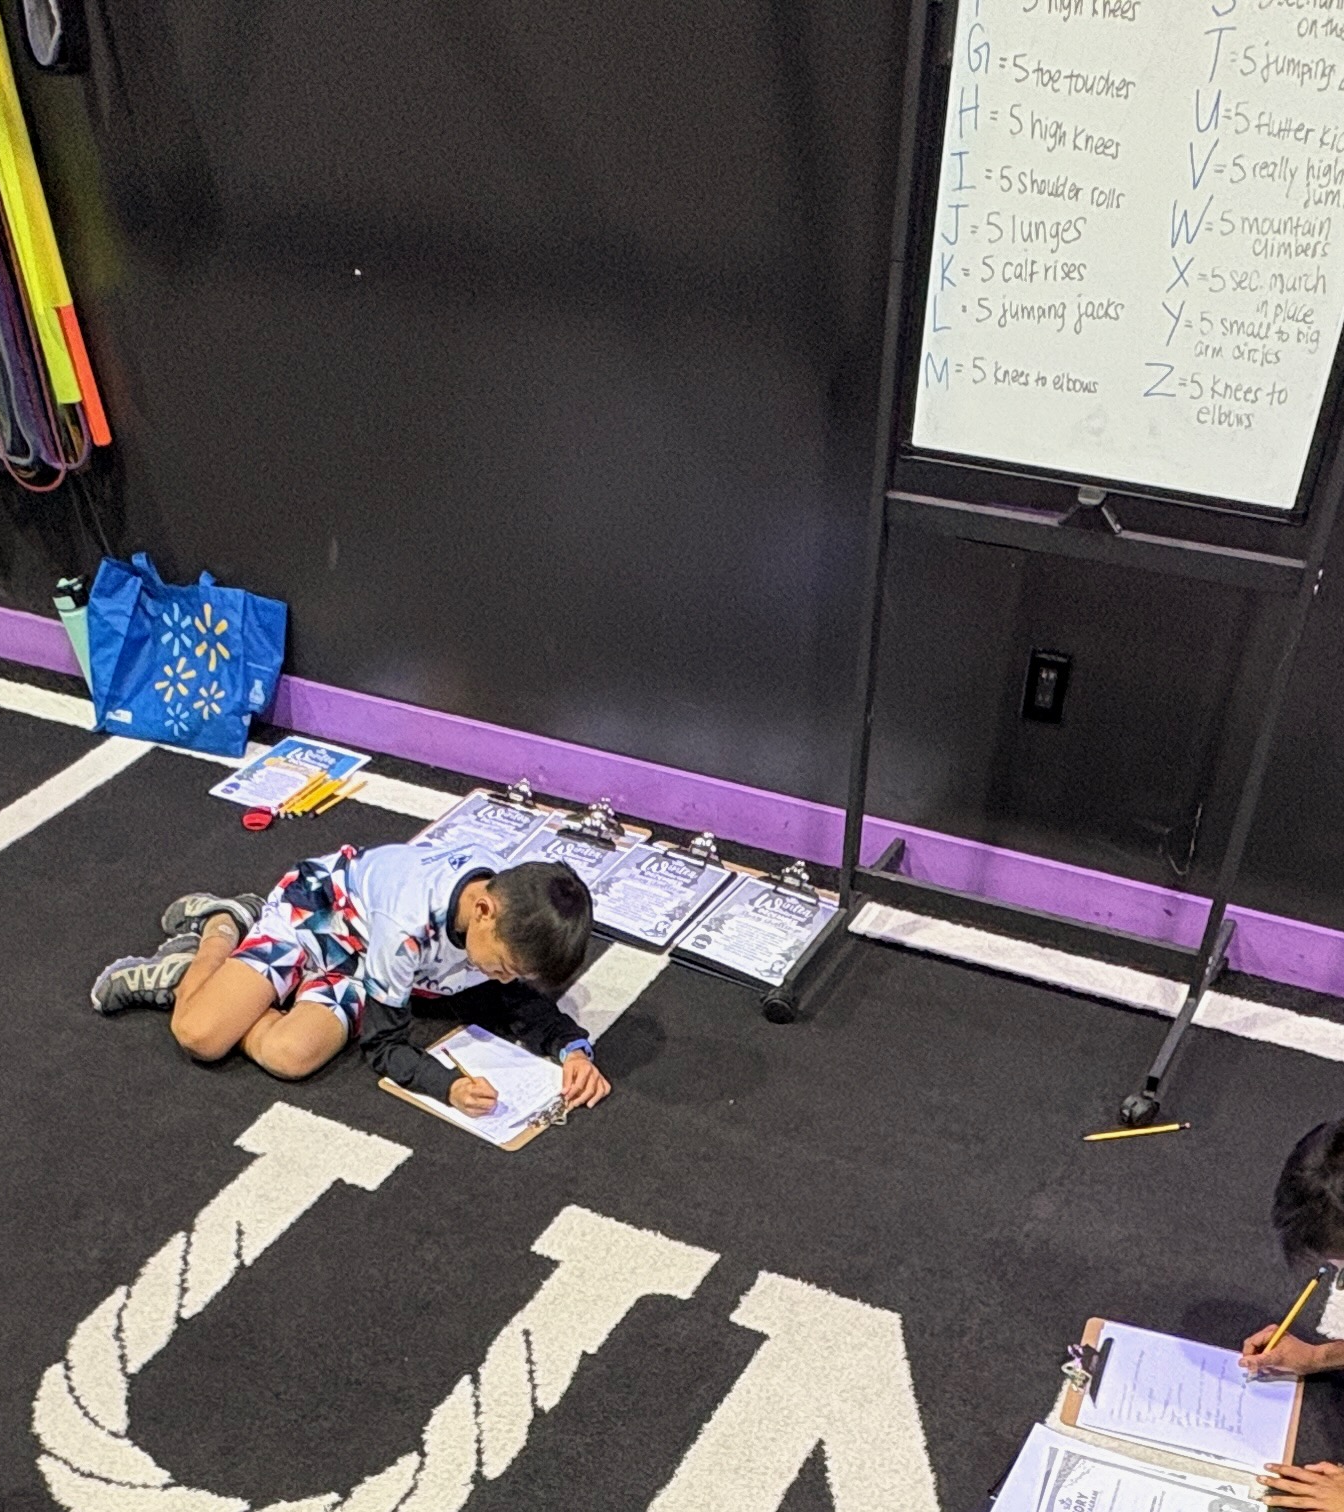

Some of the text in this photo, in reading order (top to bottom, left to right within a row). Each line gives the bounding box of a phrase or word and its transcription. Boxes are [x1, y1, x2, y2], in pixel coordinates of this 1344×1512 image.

[1297, 17, 1318, 39] on
[1032, 60, 1061, 93] toe
[1063, 69, 1136, 99] touches
[1260, 40, 1336, 92] jumping
[1031, 110, 1066, 152] high
[1255, 111, 1315, 144] flutter
[1252, 156, 1298, 199] really
[1307, 157, 1344, 189] high
[1091, 186, 1126, 209] rolls
[1012, 214, 1087, 254] lunges
[1241, 216, 1332, 238] mountain
[1002, 257, 1039, 283] calf
[1043, 260, 1087, 282] rises
[1269, 266, 1327, 295] march
[998, 295, 1066, 333] jumping
[1074, 294, 1125, 335] jacks
[1273, 300, 1314, 325] place
[1194, 340, 1224, 359] arm
[1220, 317, 1271, 340] small
[1275, 327, 1290, 343] to
[1297, 326, 1321, 354] big
[1035, 371, 1048, 387] to
[1053, 373, 1099, 394] elbows
[1266, 381, 1288, 406] to
